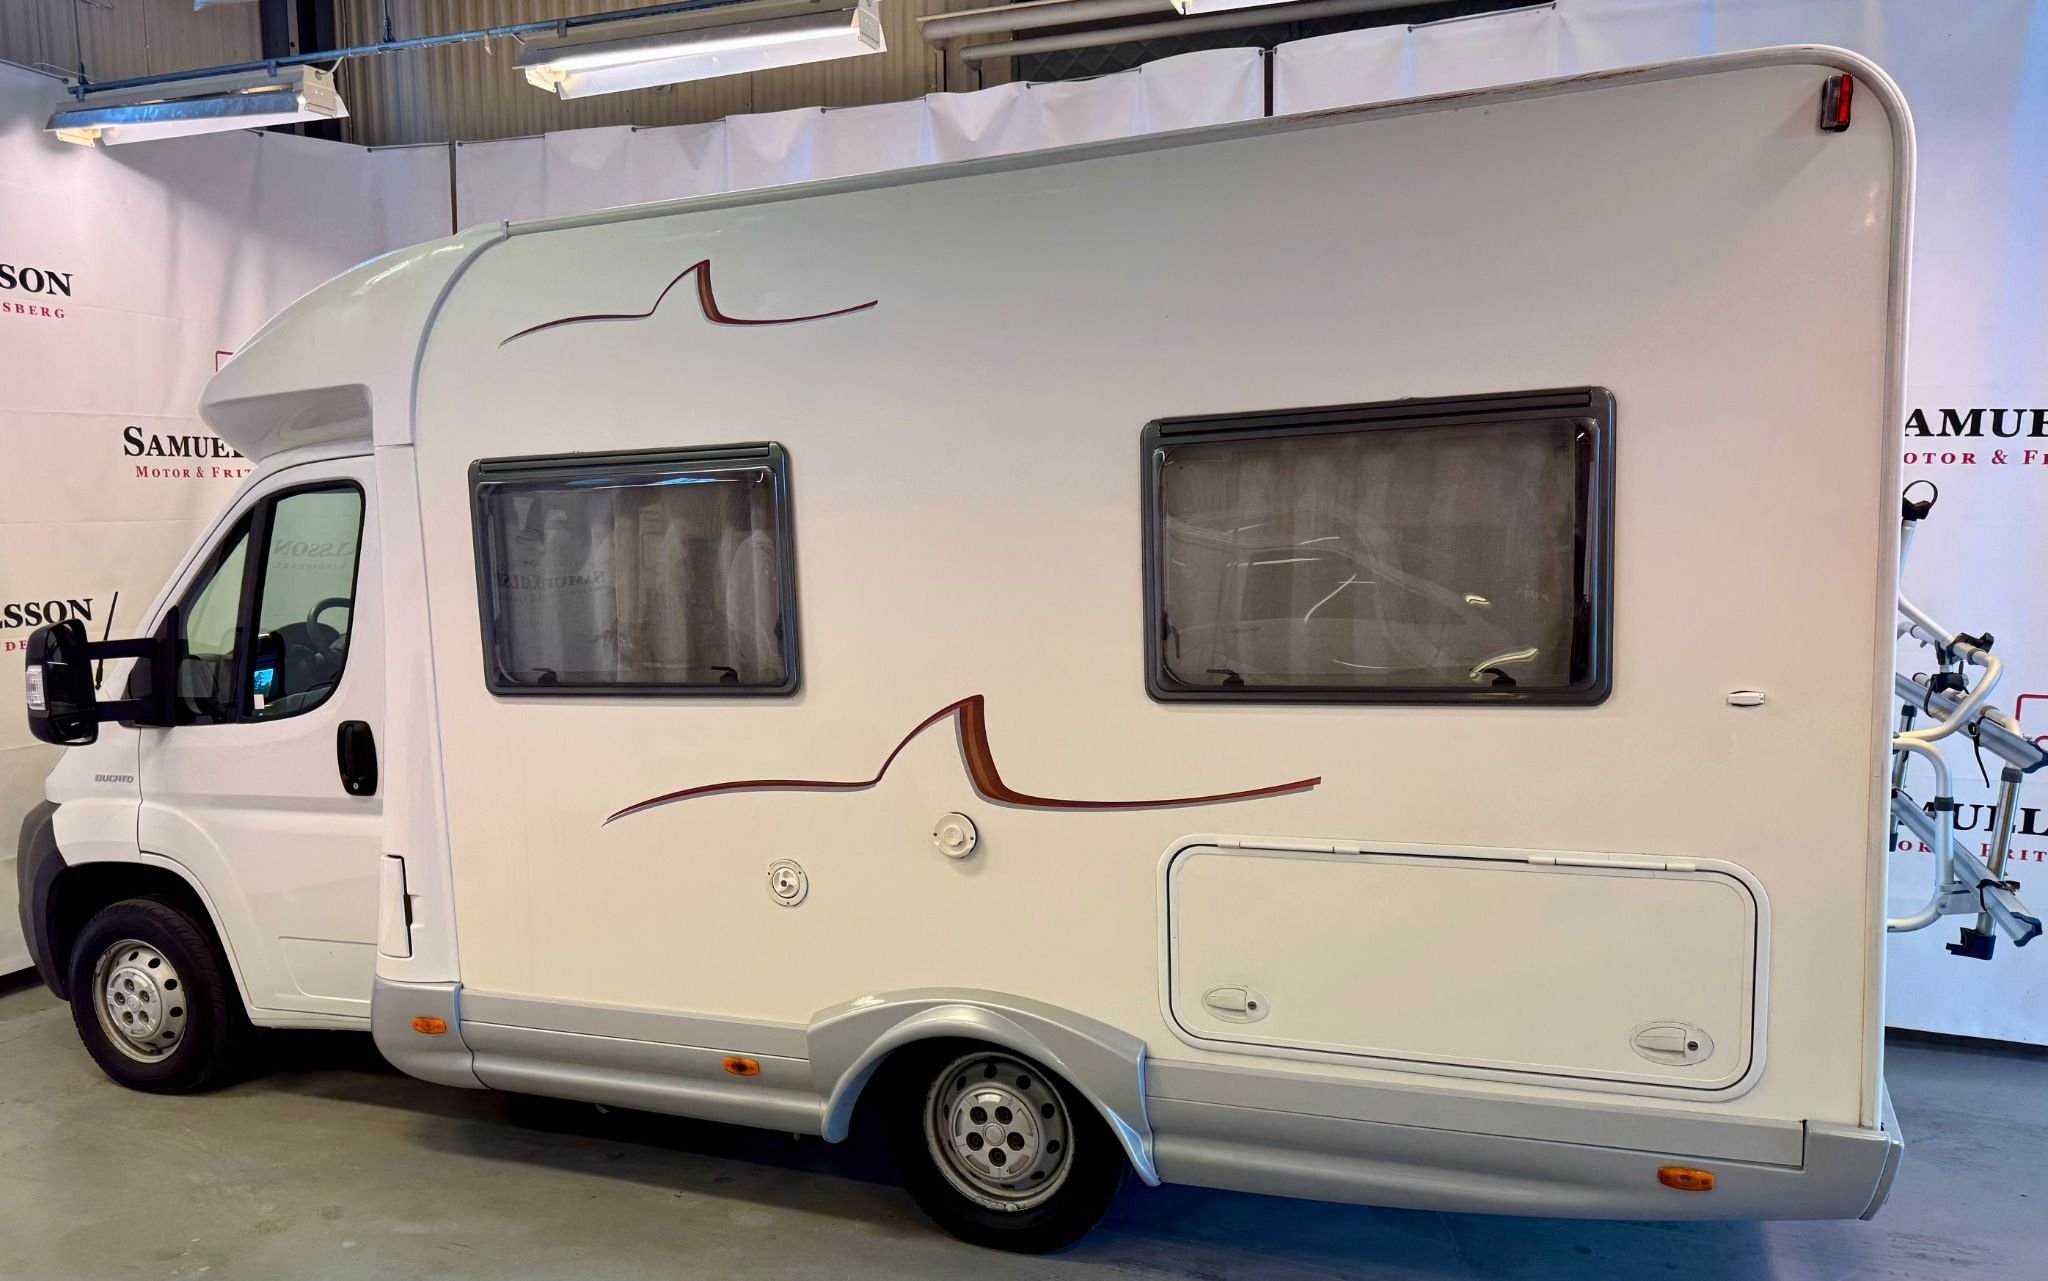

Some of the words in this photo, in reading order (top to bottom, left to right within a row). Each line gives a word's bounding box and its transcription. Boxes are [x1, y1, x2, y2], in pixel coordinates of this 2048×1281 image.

[0, 263, 73, 297] SON
[2, 302, 65, 319] SBERG
[1903, 452, 1976, 465] OTOR
[1991, 449, 2008, 465] &
[135, 465, 191, 478] MOTOR
[196, 466, 204, 478] &
[0, 598, 93, 629] SSON
[0, 640, 27, 651] DE
[95, 774, 134, 783] DUCATO
